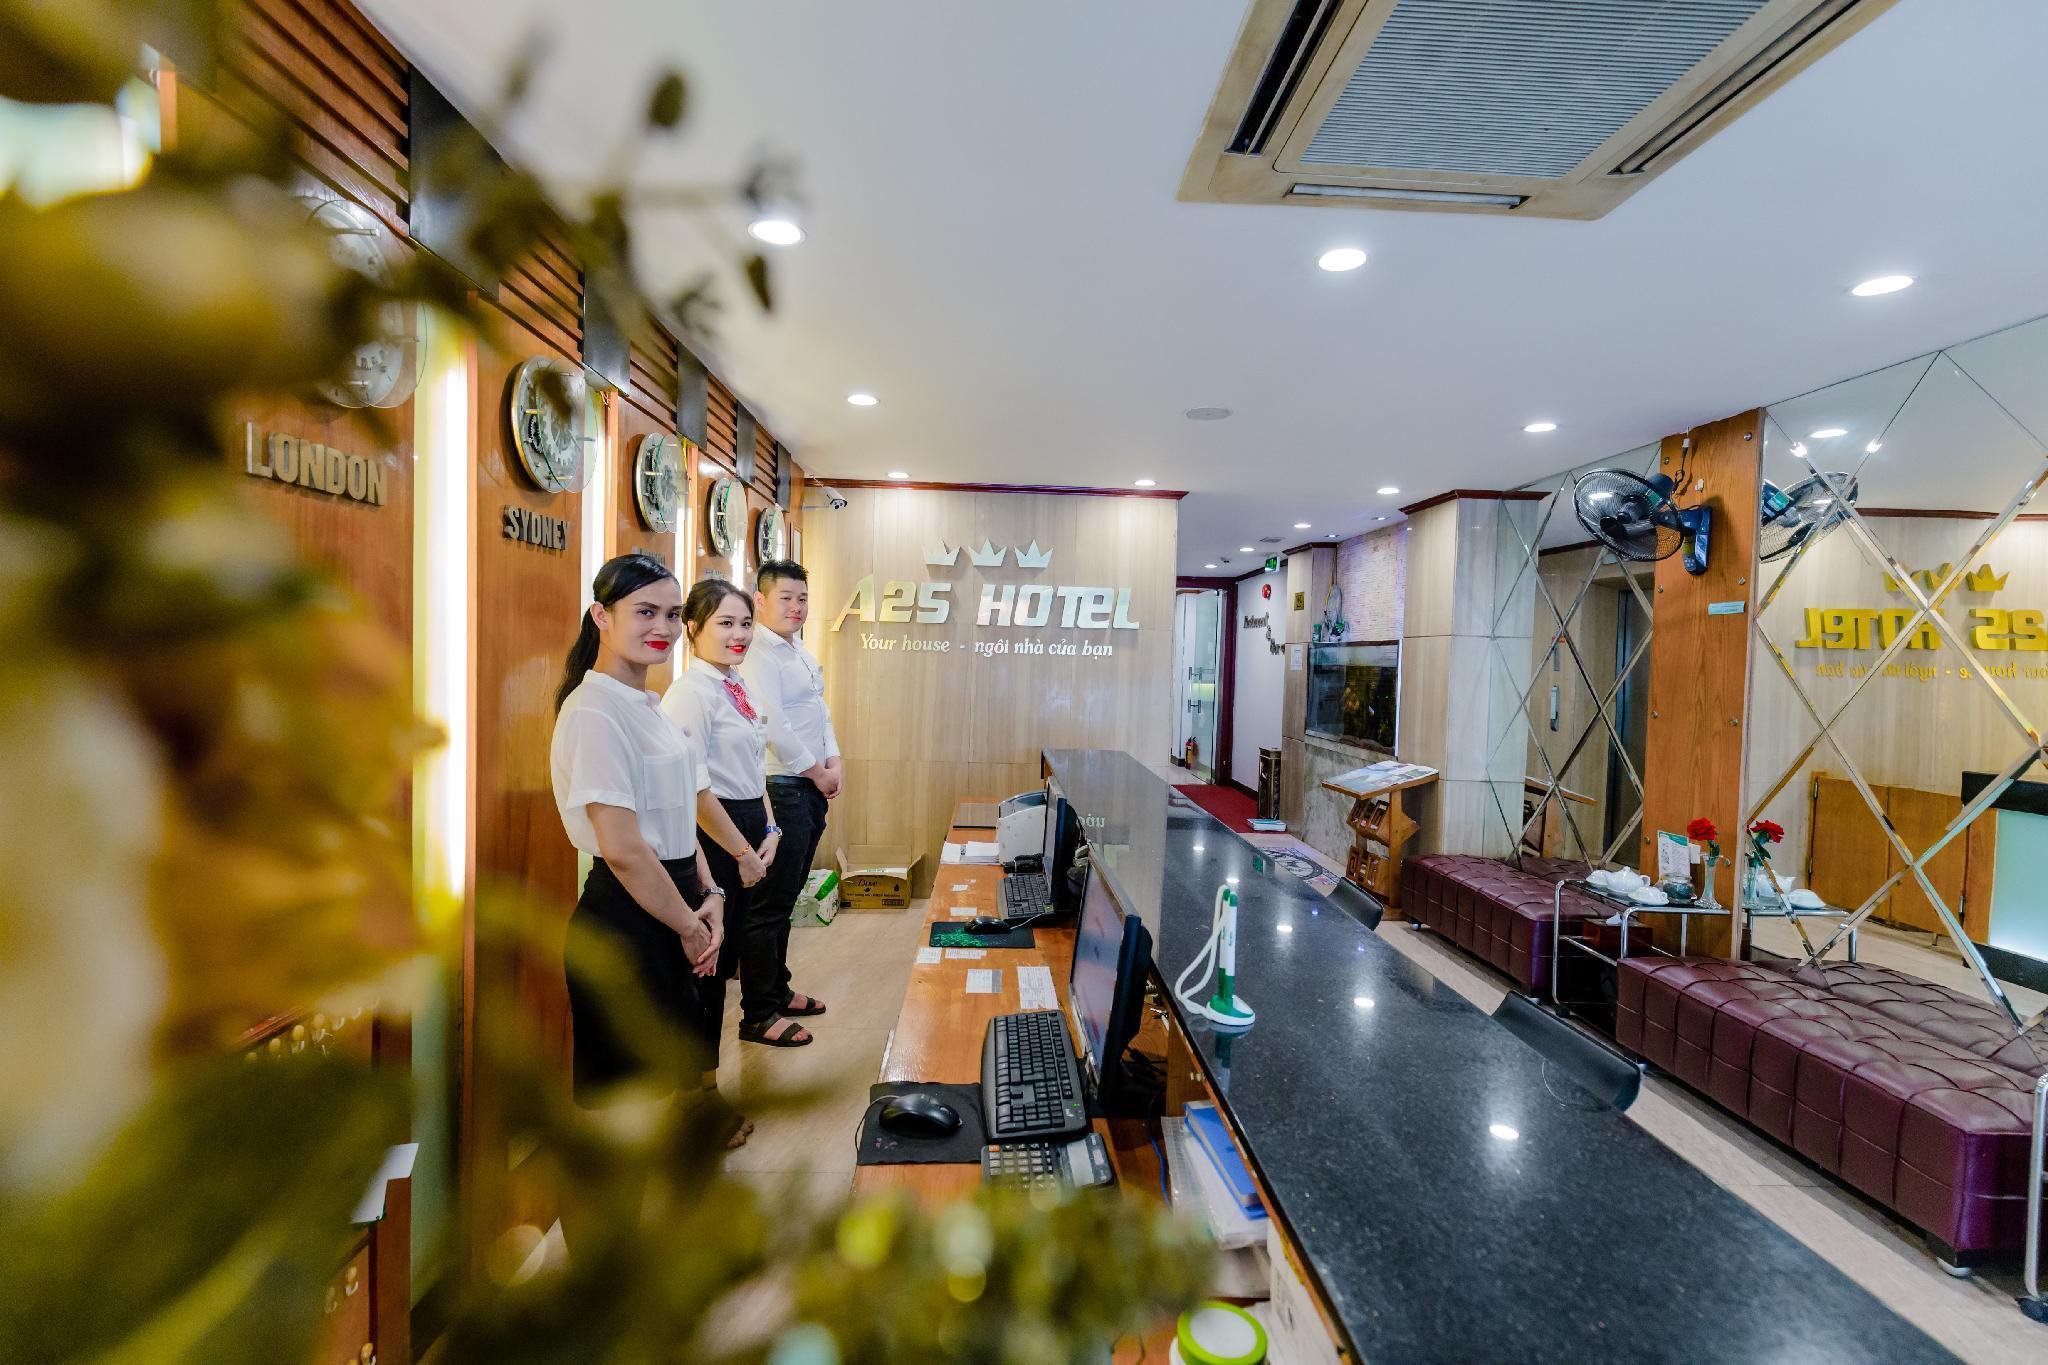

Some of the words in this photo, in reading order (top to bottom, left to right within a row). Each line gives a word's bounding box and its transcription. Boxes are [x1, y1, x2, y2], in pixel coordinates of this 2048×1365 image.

[247, 420, 387, 506] LONDON
[503, 505, 570, 550] SYDNEY
[830, 574, 951, 631] A25
[860, 632, 897, 650] Your
[902, 634, 950, 651] house
[975, 638, 1008, 657] ngôi
[1014, 638, 1044, 655] nhà
[1049, 638, 1077, 656] của
[1082, 639, 1113, 660] bạn
